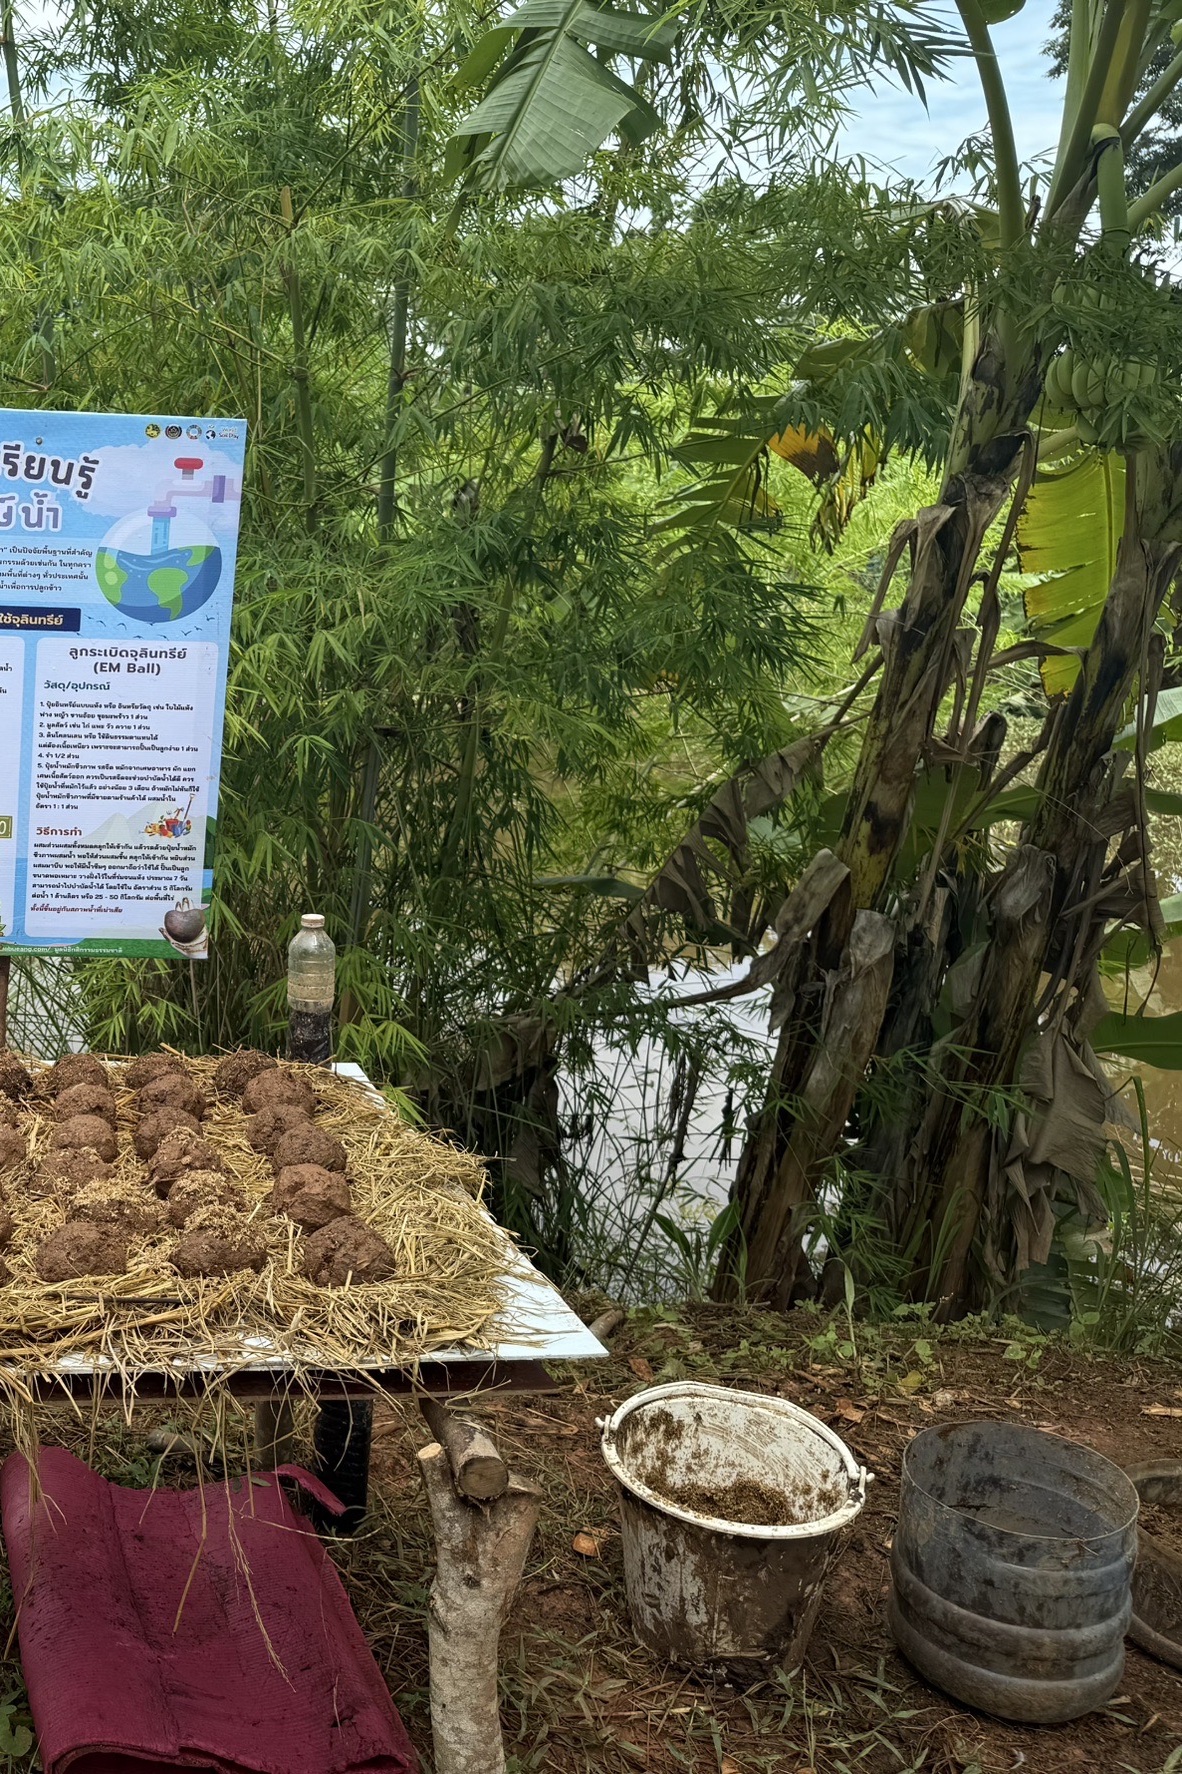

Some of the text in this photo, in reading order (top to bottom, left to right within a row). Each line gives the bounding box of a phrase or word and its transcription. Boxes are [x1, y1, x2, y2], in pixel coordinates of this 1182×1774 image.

[58, 559, 92, 570] ในทุกครา
[69, 646, 188, 661] ลูกระเบิดจุลินทรีย์
[93, 662, 161, 676] (EM Ball)
[43, 679, 111, 692] วัสดุ/อุปกรณ์
[103, 701, 117, 709] หรือ
[53, 711, 69, 720] หญ้า
[81, 721, 91, 729] ไก่
[137, 723, 151, 731] ส่วน
[83, 732, 97, 740] หรือ
[36, 826, 82, 836] วิธีการทำ
[179, 874, 188, 882] วัน
[80, 892, 94, 900] หรือ
